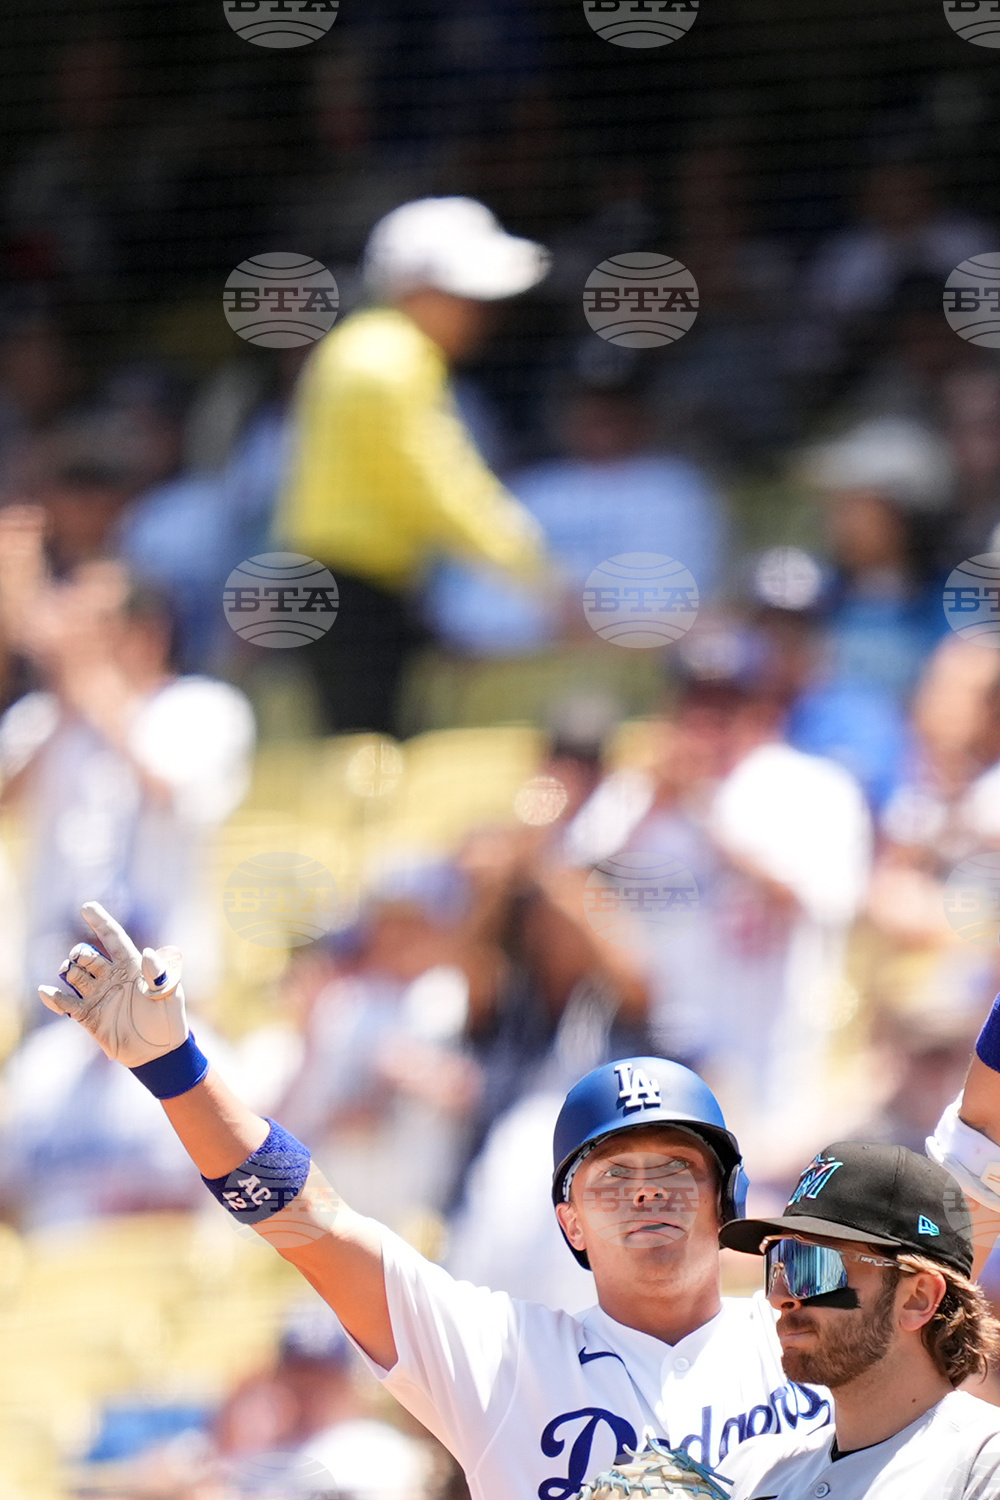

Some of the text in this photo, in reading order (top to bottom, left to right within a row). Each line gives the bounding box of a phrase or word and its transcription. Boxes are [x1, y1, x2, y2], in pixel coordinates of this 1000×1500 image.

[614, 1063, 662, 1108] LA
[222, 1191, 247, 1211] 12
[237, 1174, 272, 1206] AC
